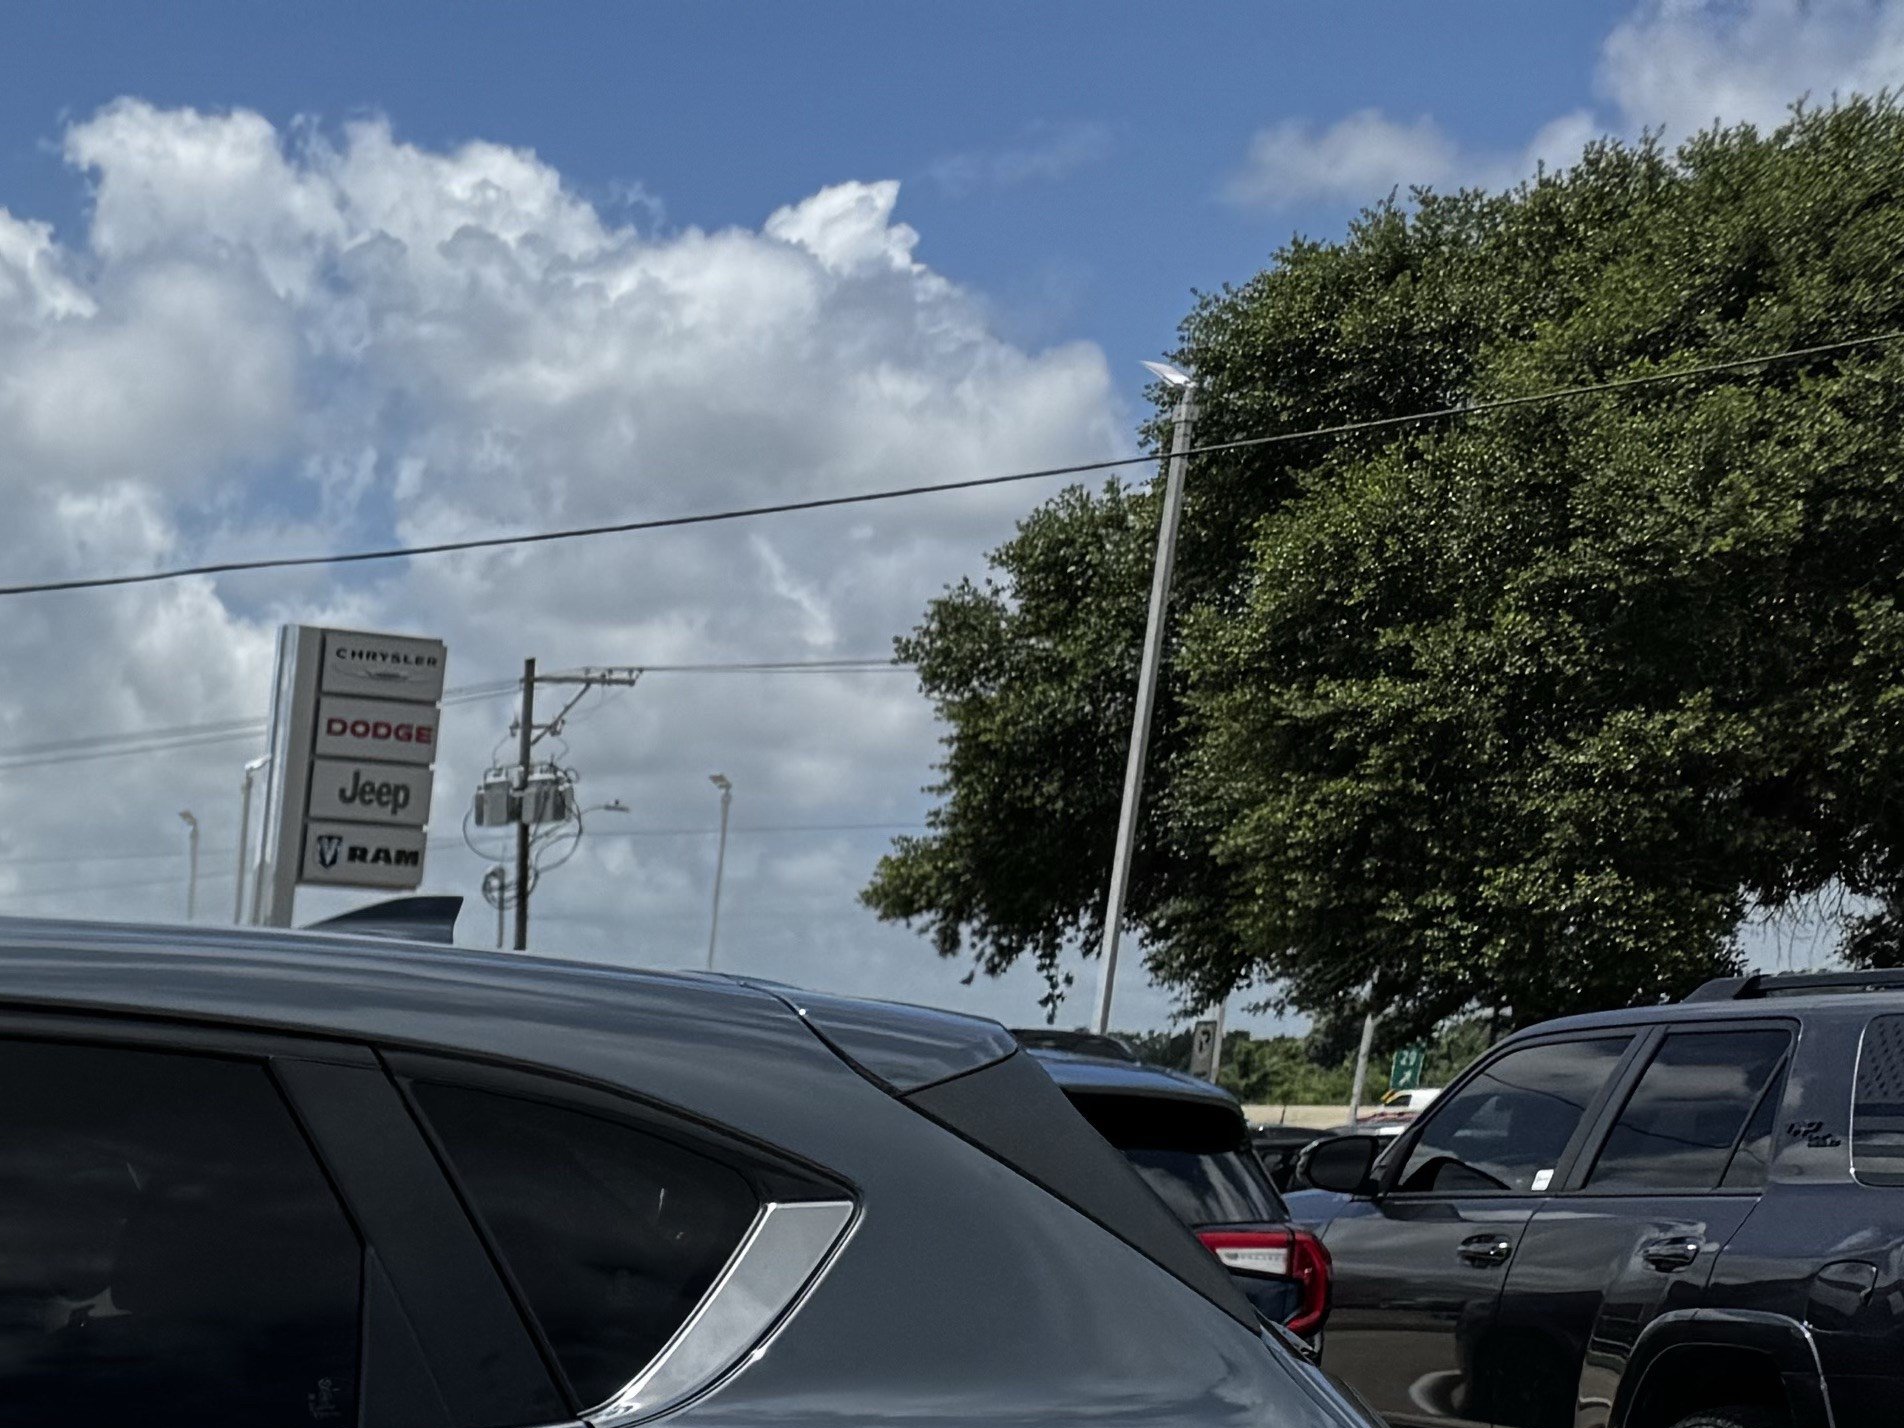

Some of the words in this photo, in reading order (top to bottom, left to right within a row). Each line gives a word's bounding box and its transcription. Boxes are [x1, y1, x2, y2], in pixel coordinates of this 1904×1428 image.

[335, 647, 438, 667] CHRYSLER
[326, 717, 433, 745] DODGE
[338, 768, 410, 816] Jeep
[346, 845, 420, 867] RAM
